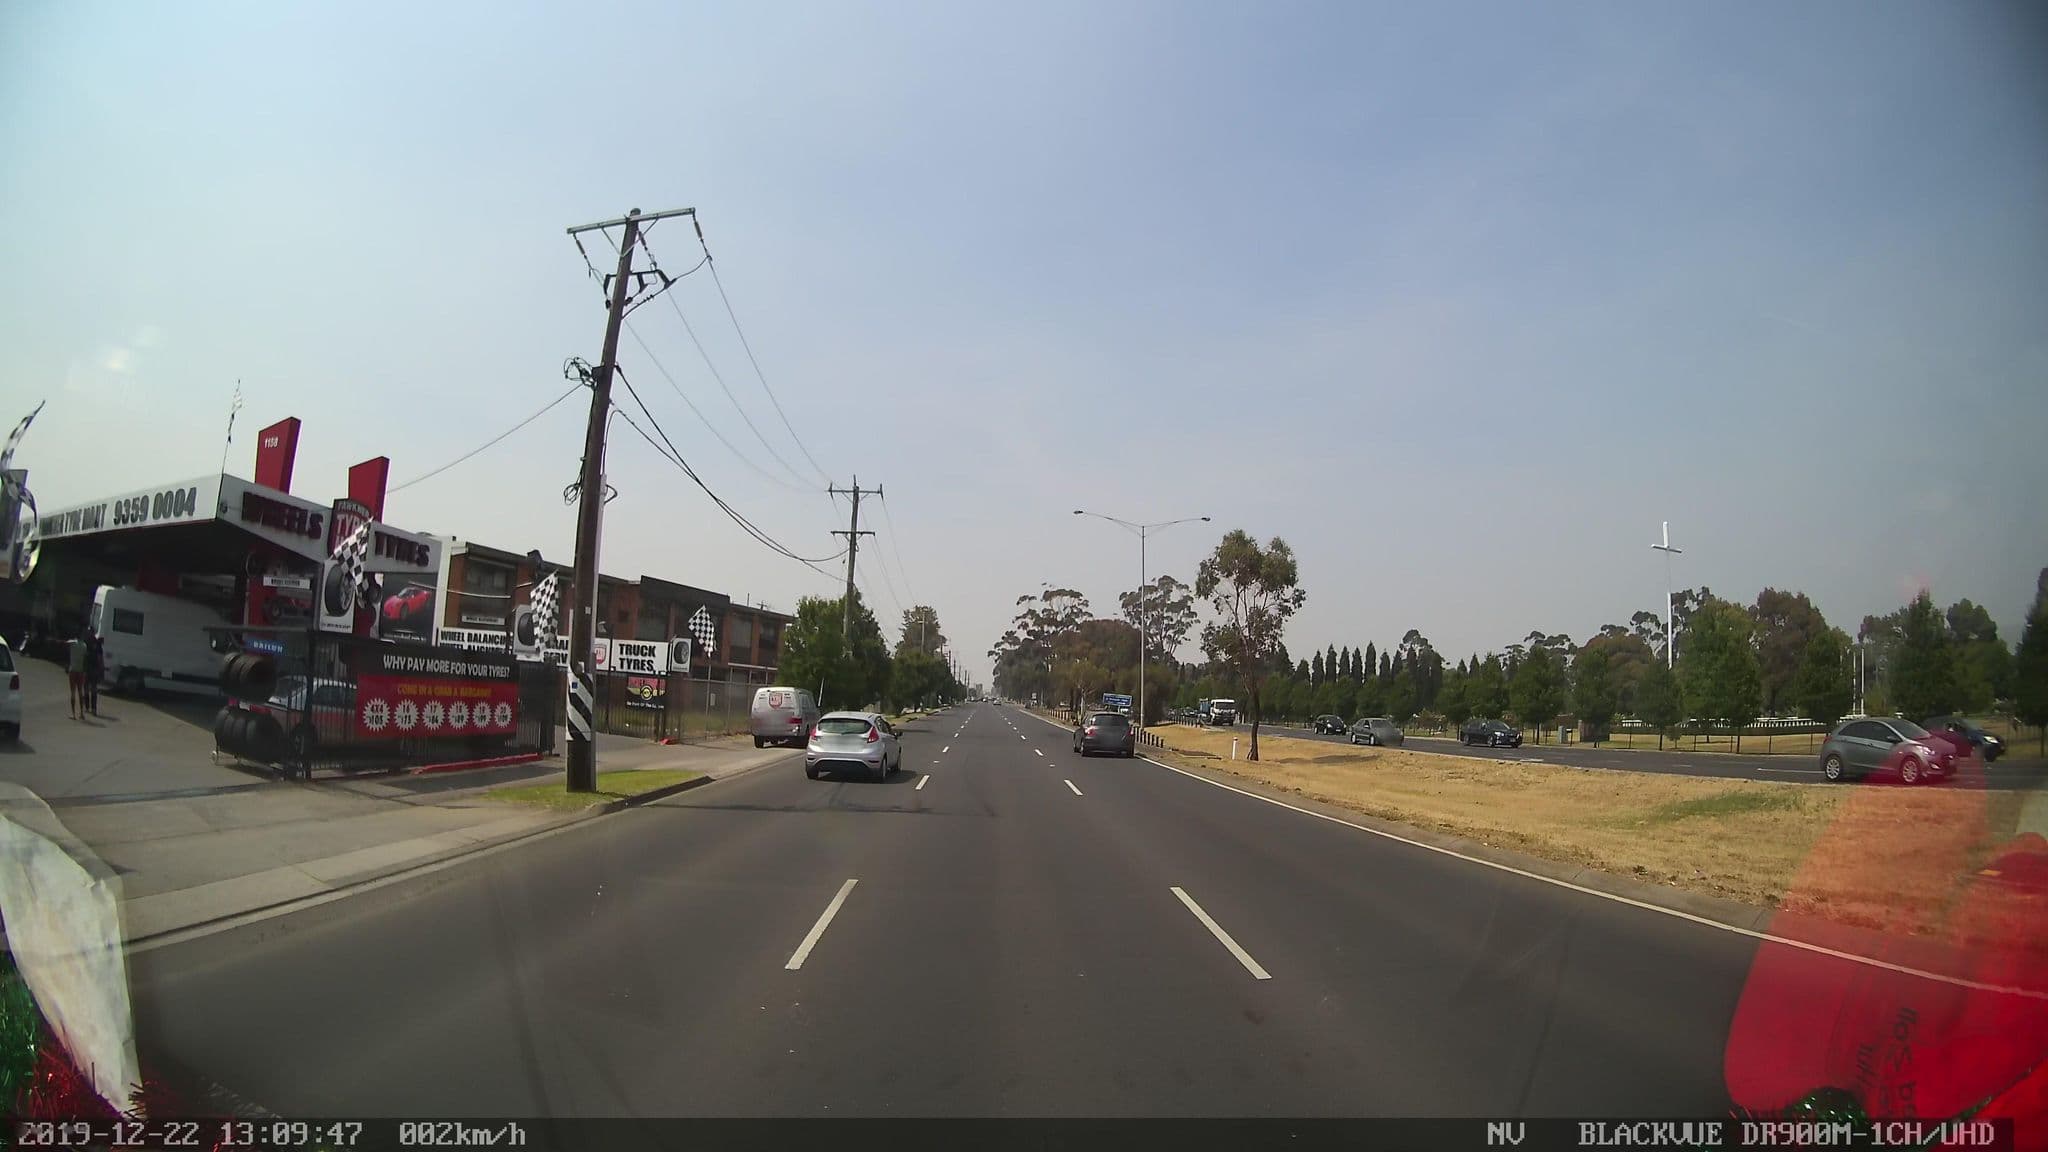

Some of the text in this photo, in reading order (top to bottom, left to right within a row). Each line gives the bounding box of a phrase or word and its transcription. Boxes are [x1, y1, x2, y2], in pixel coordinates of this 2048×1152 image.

[113, 495, 150, 526] 9359
[152, 487, 197, 521] 0004
[440, 630, 465, 642] WHEEL
[619, 643, 656, 657] TRUCK
[383, 654, 406, 671] WHY
[407, 657, 425, 672] PAY
[426, 659, 450, 674] MORE
[450, 661, 467, 676] FOR
[467, 663, 488, 677] YOUR
[619, 657, 655, 671] TYRES
